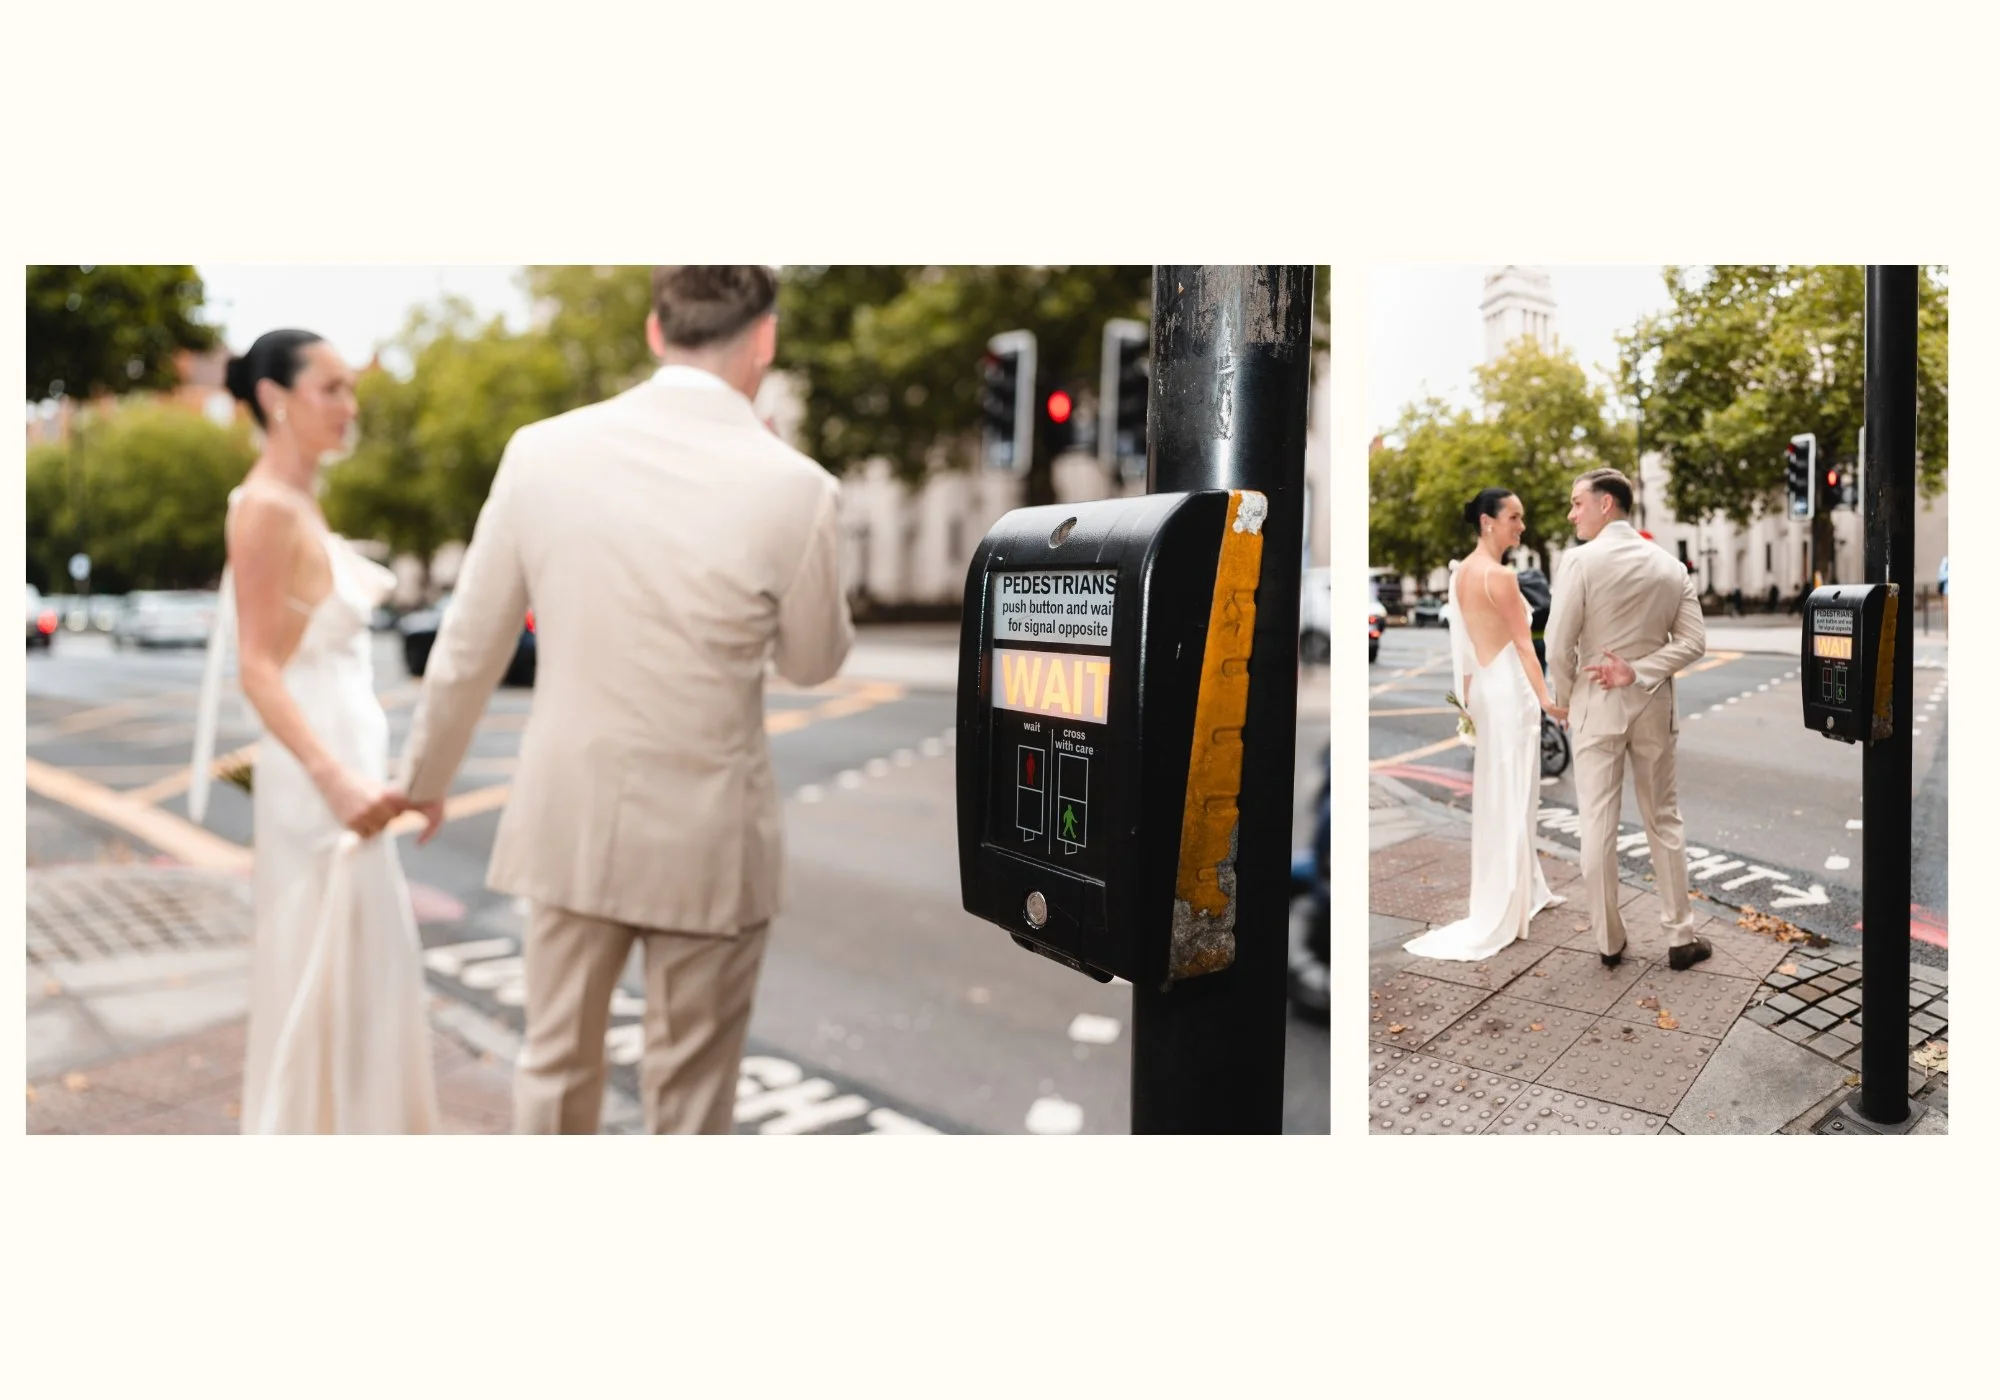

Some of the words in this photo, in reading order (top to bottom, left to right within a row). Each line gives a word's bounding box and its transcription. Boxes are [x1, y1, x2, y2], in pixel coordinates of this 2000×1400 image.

[1003, 575, 1117, 595] PEDESTRIANS
[1002, 601, 1027, 615] push
[1029, 600, 1064, 614] button
[1066, 601, 1088, 615] and
[1091, 601, 1114, 616] wai
[1008, 617, 1022, 632] for
[1024, 619, 1056, 636] signal
[1058, 622, 1108, 637] opposite
[1817, 637, 1852, 657] WAIT
[1002, 654, 1111, 719] WAIT
[1024, 721, 1041, 733] wait
[1063, 728, 1086, 740] cross
[1055, 739, 1074, 752] with
[1075, 744, 1094, 756] care
